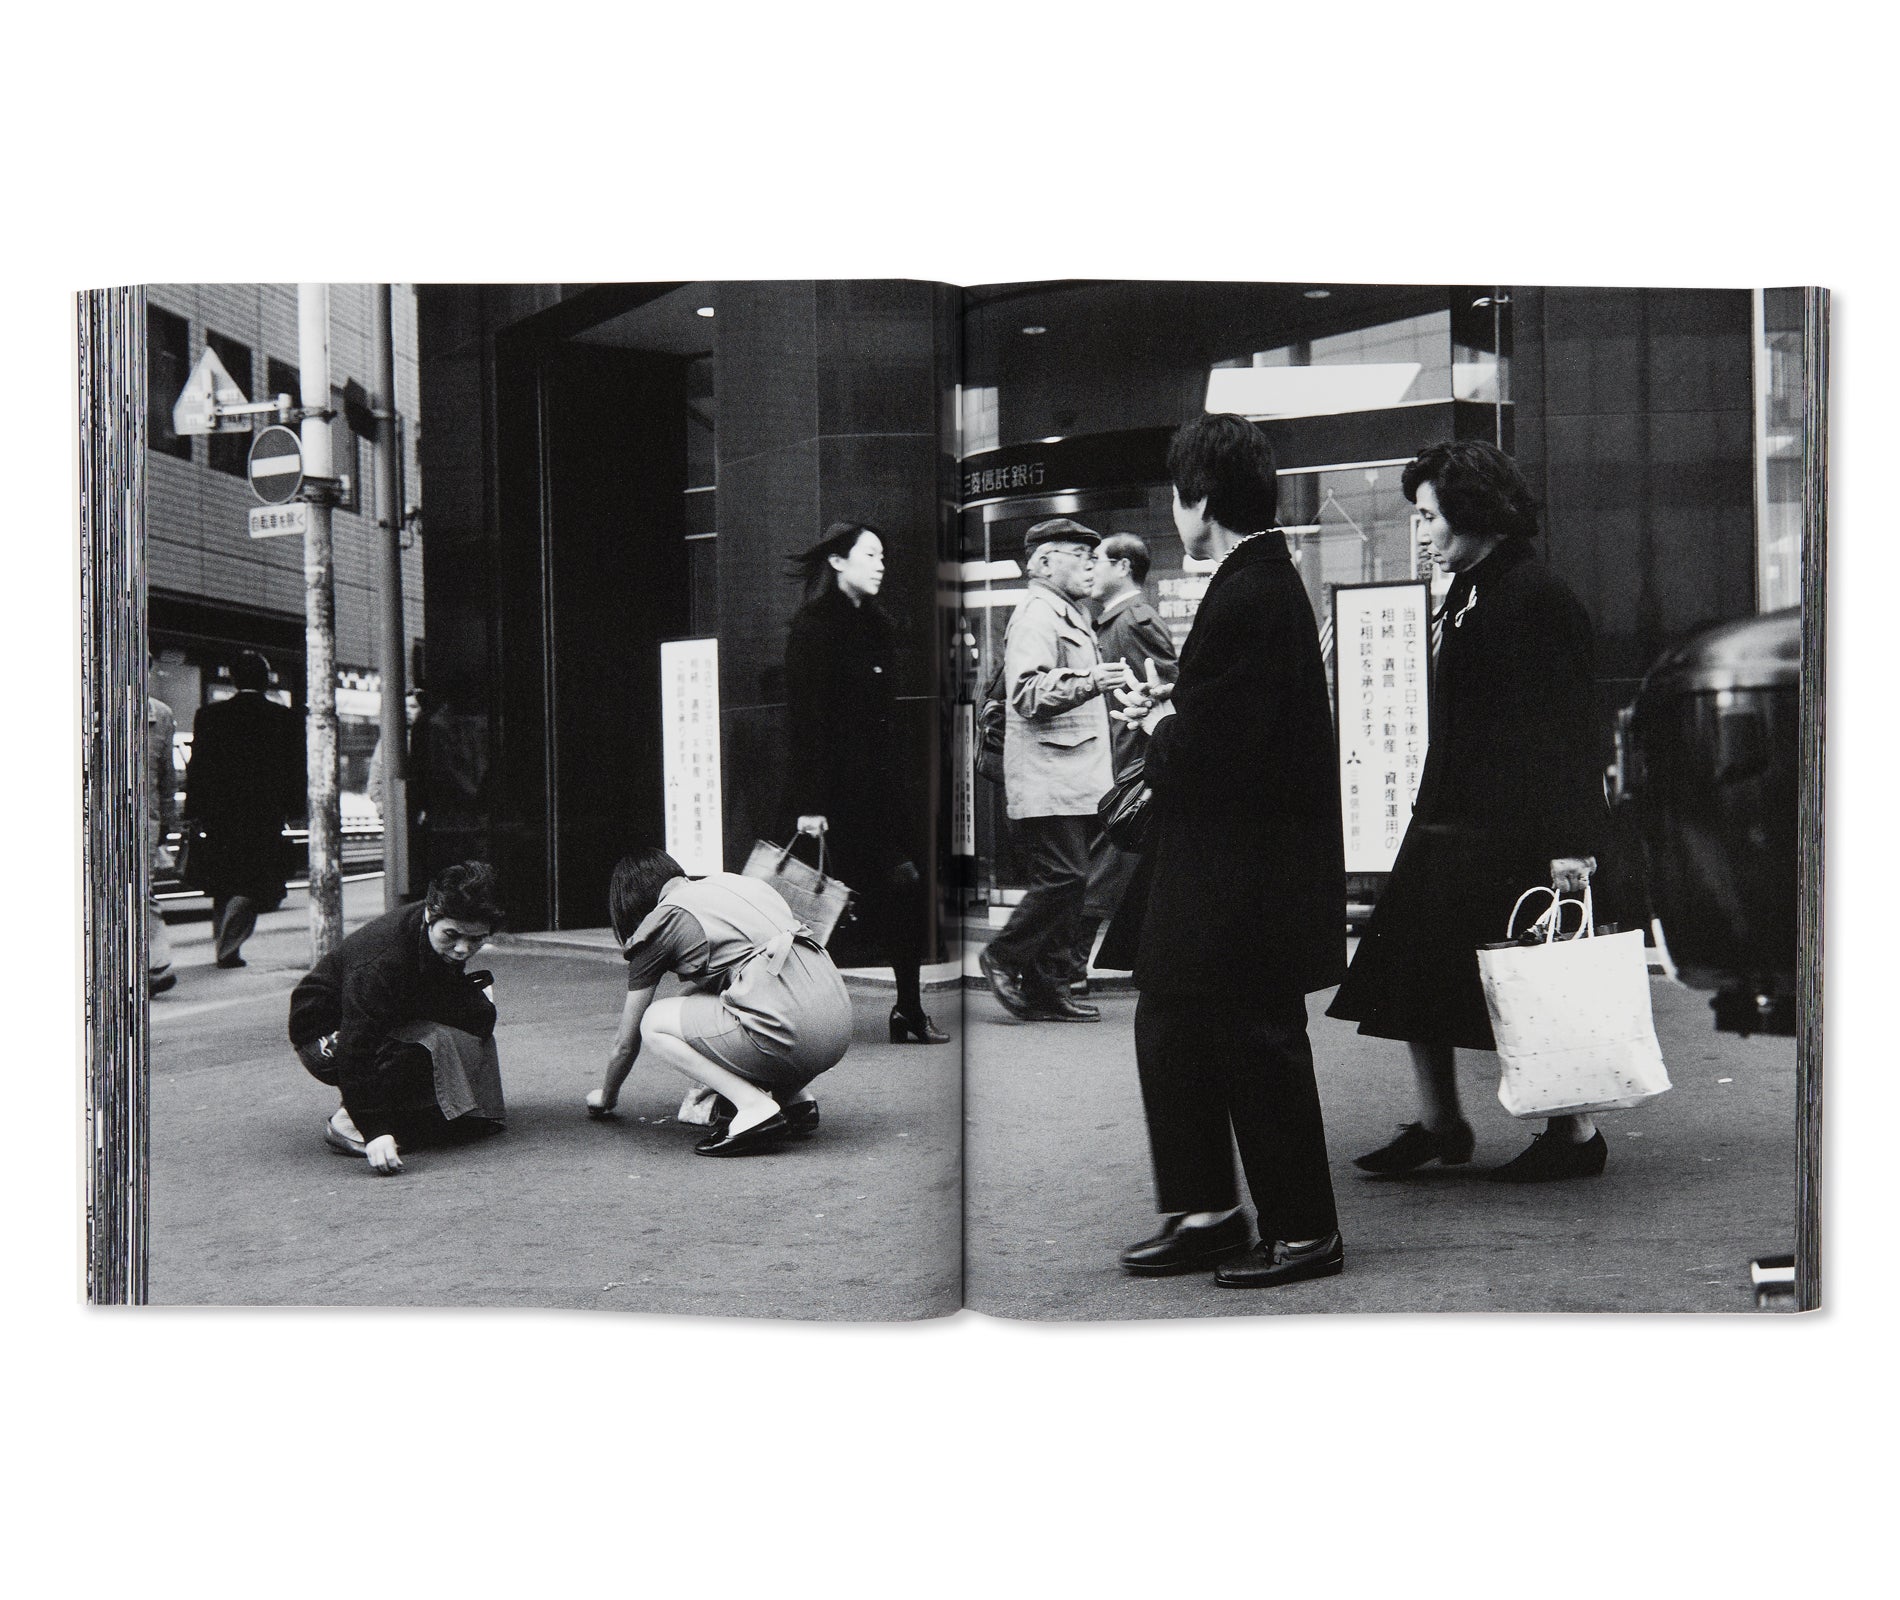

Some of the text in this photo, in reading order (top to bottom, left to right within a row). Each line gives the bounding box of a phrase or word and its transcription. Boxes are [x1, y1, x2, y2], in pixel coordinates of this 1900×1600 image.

[964, 462, 1045, 496] 三菱信託銀行
